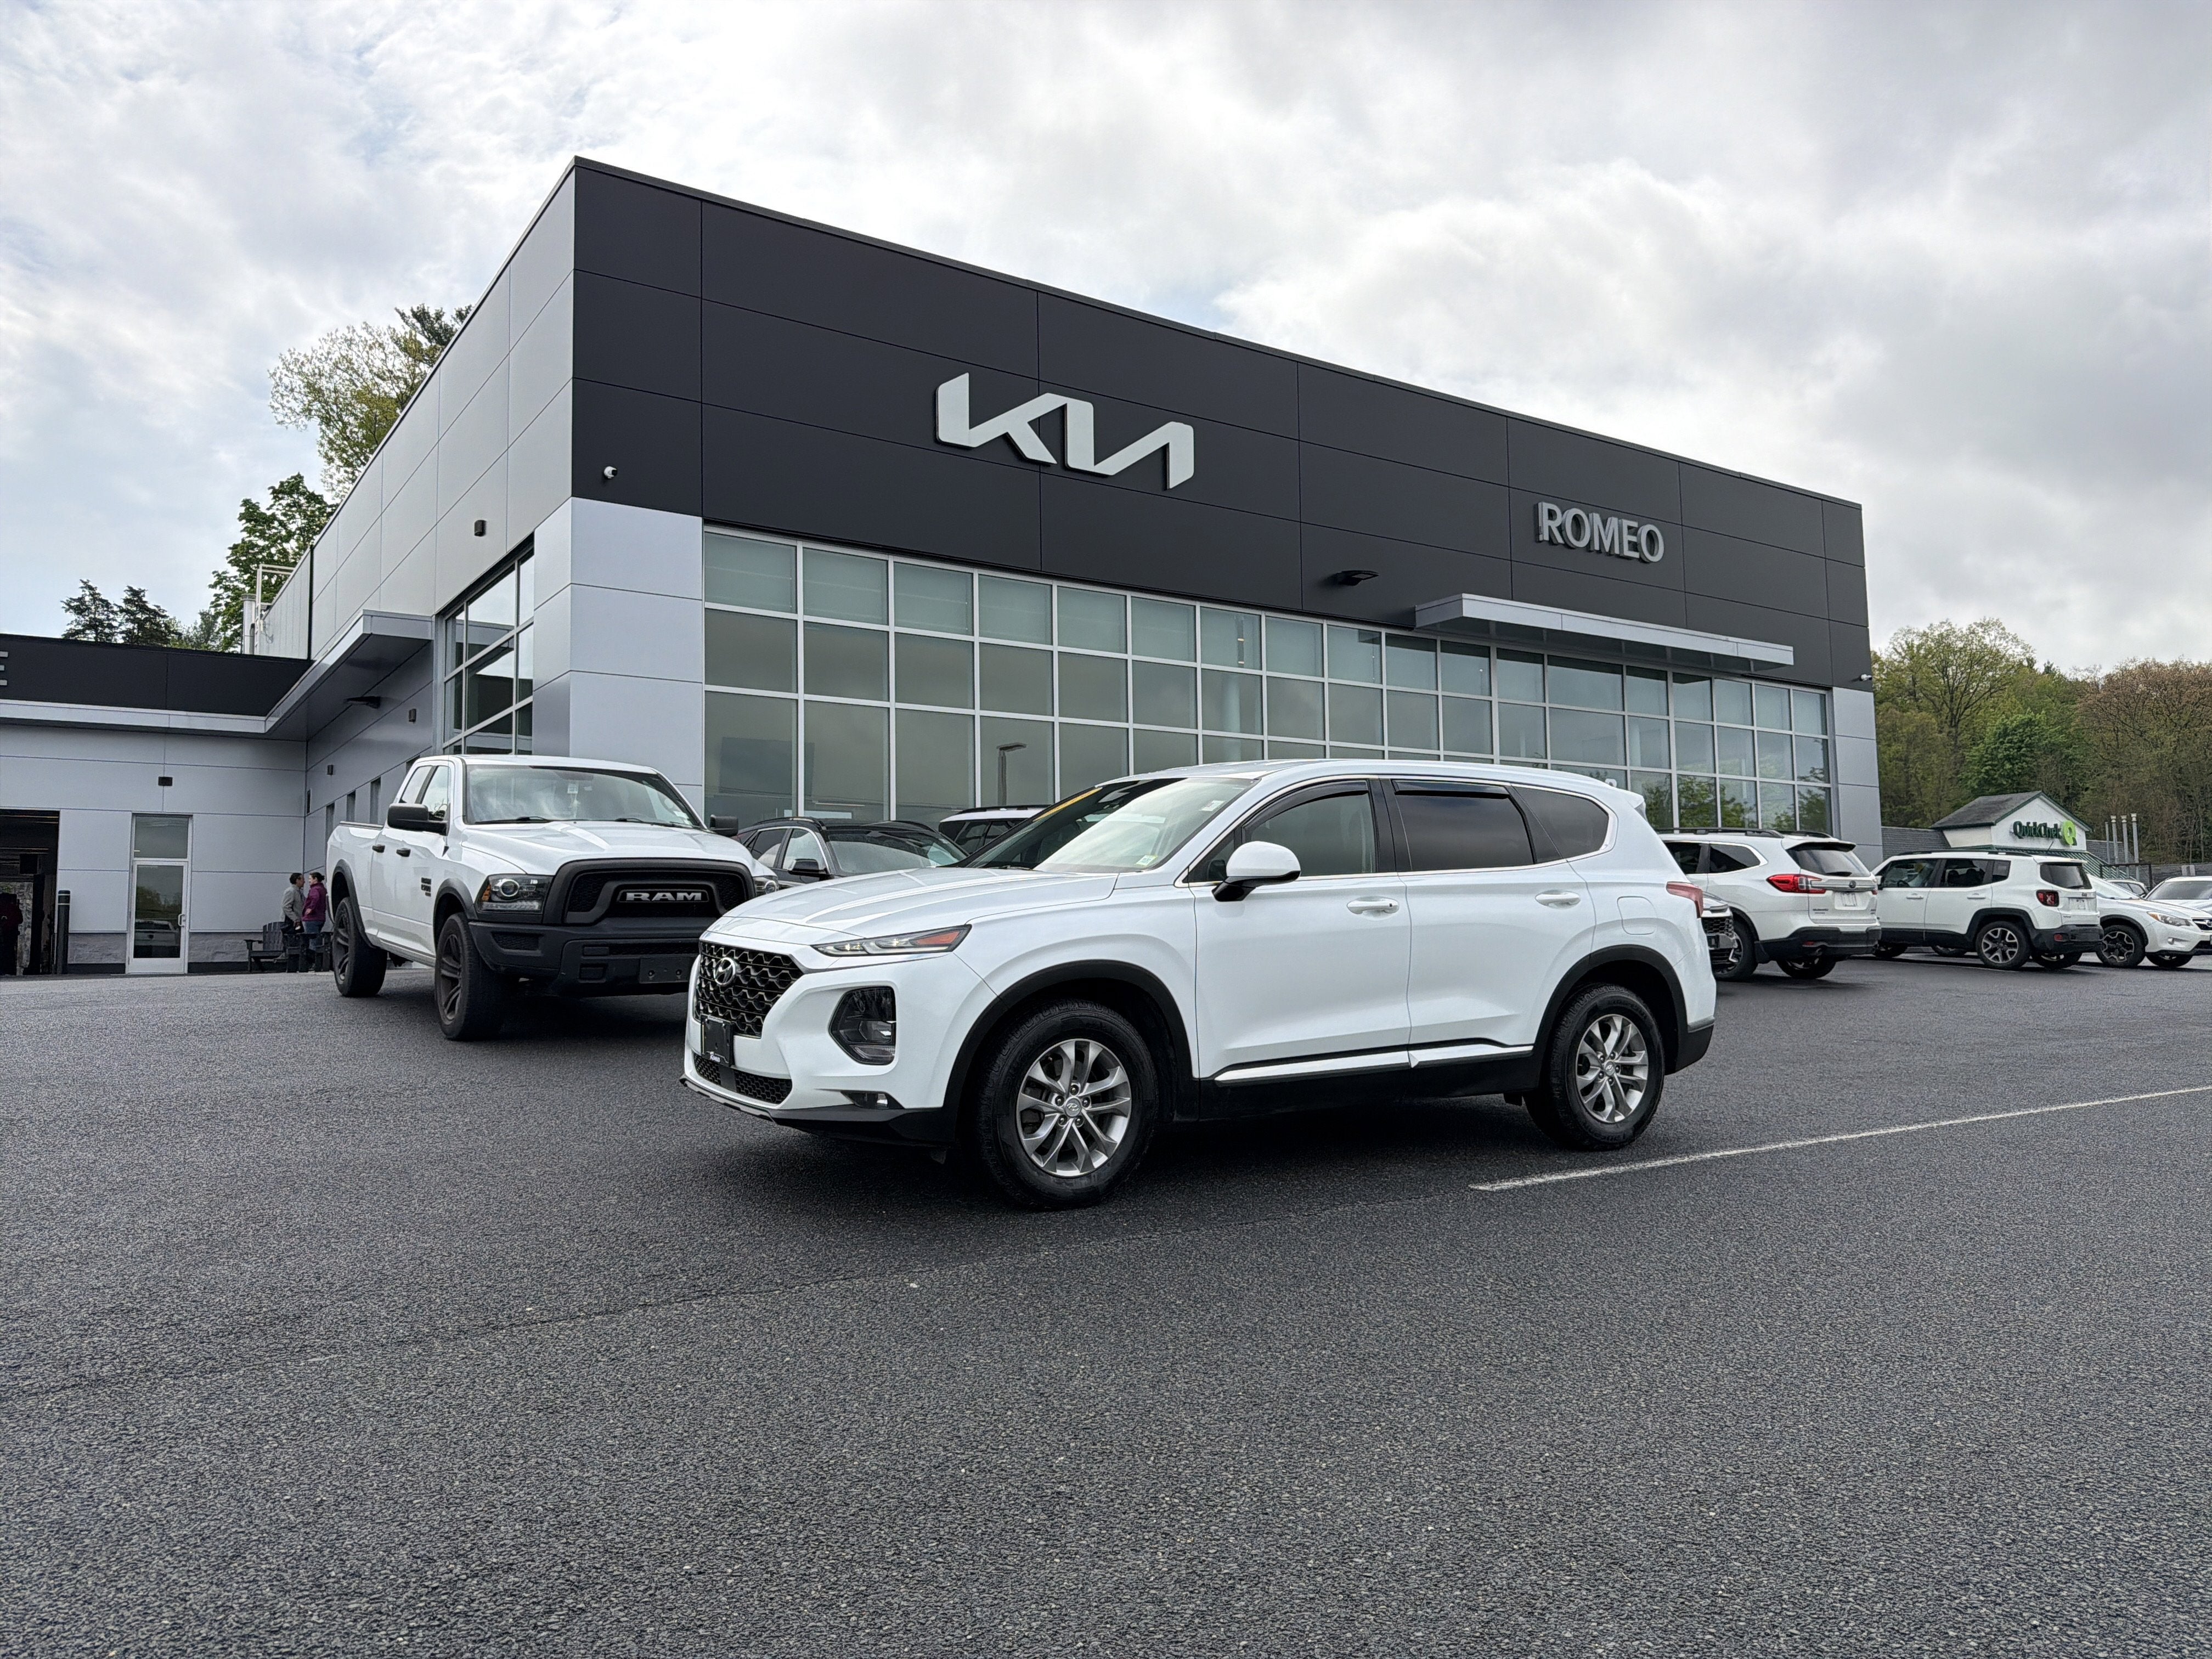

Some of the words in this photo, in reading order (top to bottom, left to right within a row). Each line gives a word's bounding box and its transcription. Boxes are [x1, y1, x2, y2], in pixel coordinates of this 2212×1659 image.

[936, 372, 1194, 490] KIA
[1537, 501, 1664, 563] ROMEO
[625, 892, 702, 901] RAM
